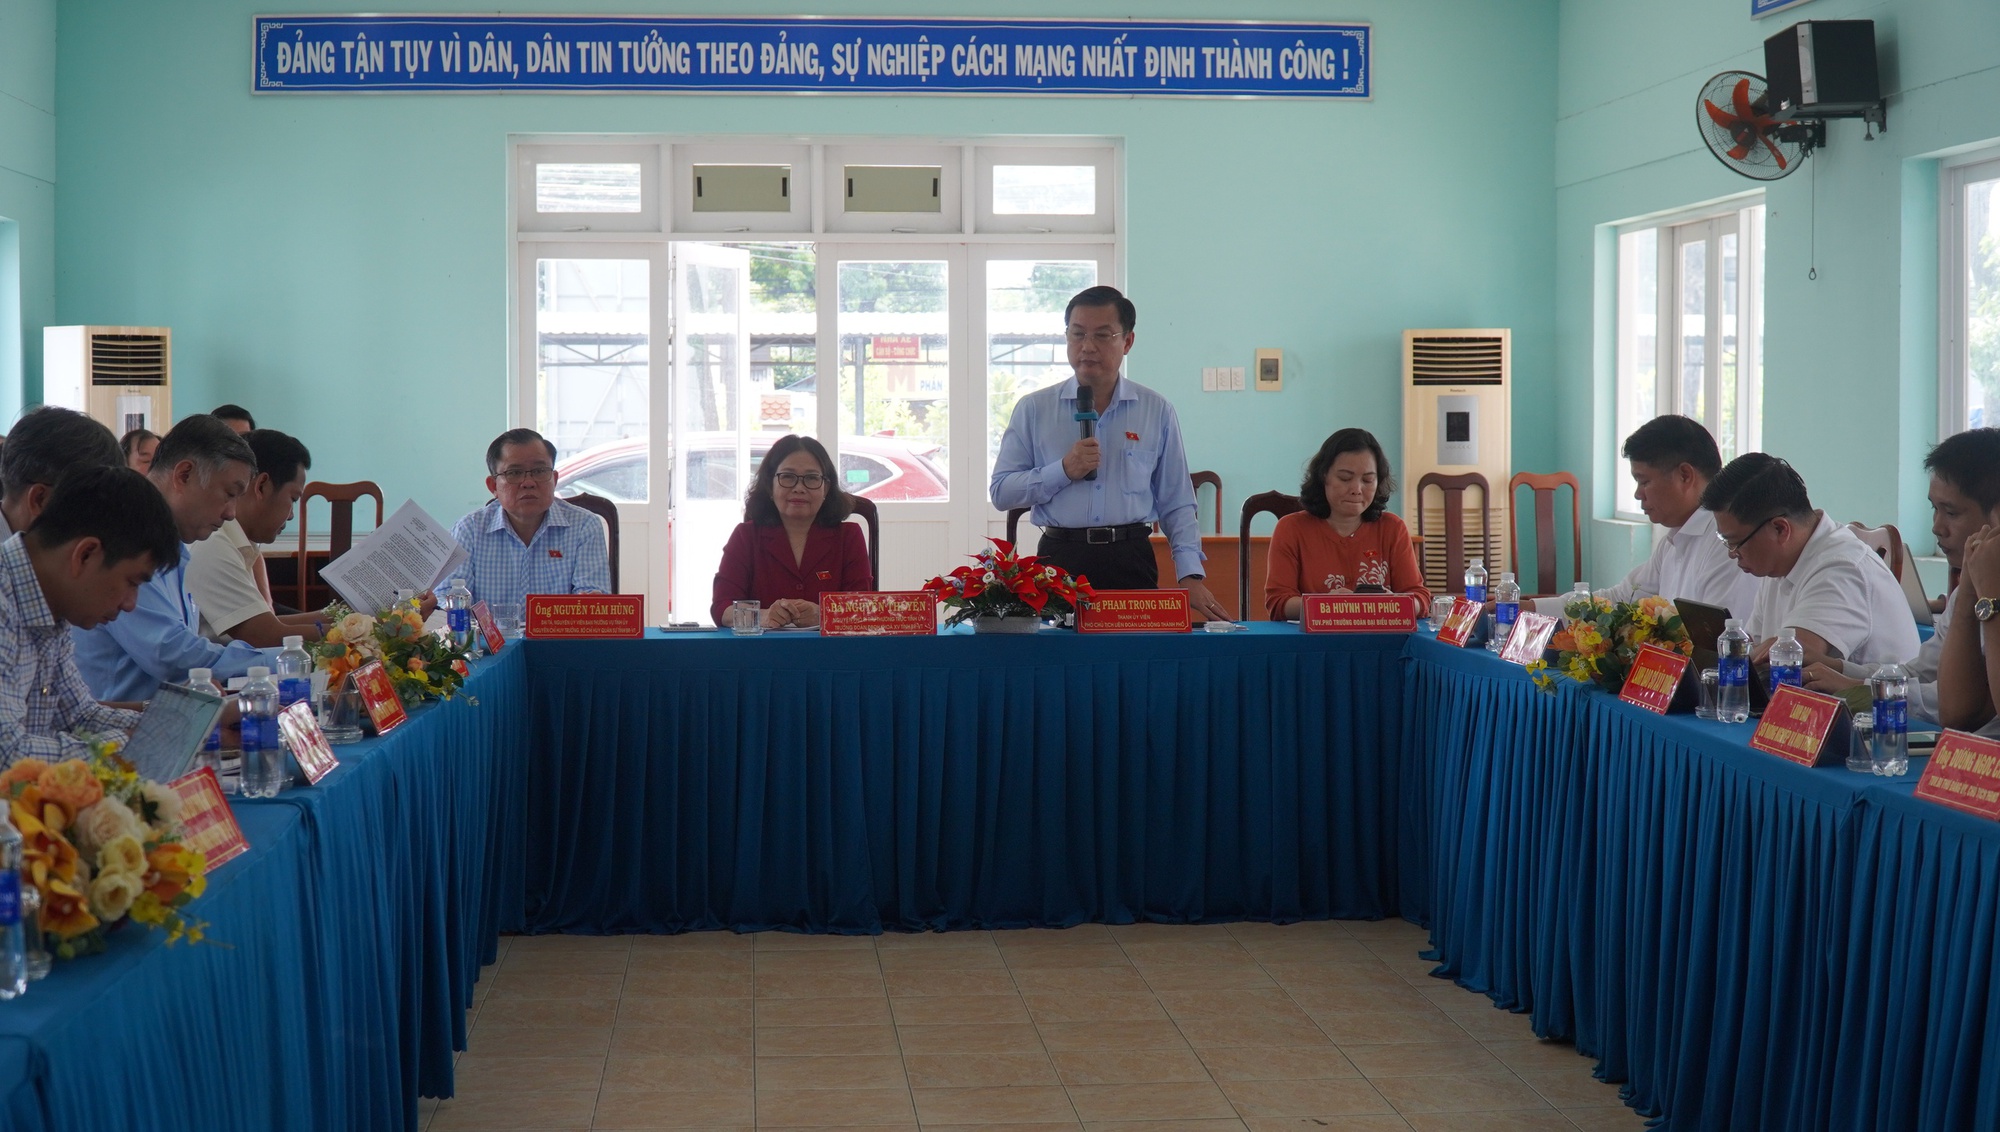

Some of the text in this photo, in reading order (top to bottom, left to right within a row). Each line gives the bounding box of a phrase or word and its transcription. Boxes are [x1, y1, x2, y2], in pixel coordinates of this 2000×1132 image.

[277, 29, 1348, 85] ĐẢNG TẬN TỤY VÌ DÂN, DÂN TIN TƯỞNG THEO ĐẢNG, SỰ NGHIỆP CÁCH MẠNG NHẤT ĐỊNH THÀNH CÔNG !
[535, 600, 635, 618] Ông NGUYỄN TÂM HÙNG
[1102, 600, 1127, 612] PHẠM
[1128, 600, 1157, 612] TRỌNG
[1159, 597, 1181, 610] NHÂN
[1320, 600, 1400, 615] Bà HUỲNH THỊ PHÚC
